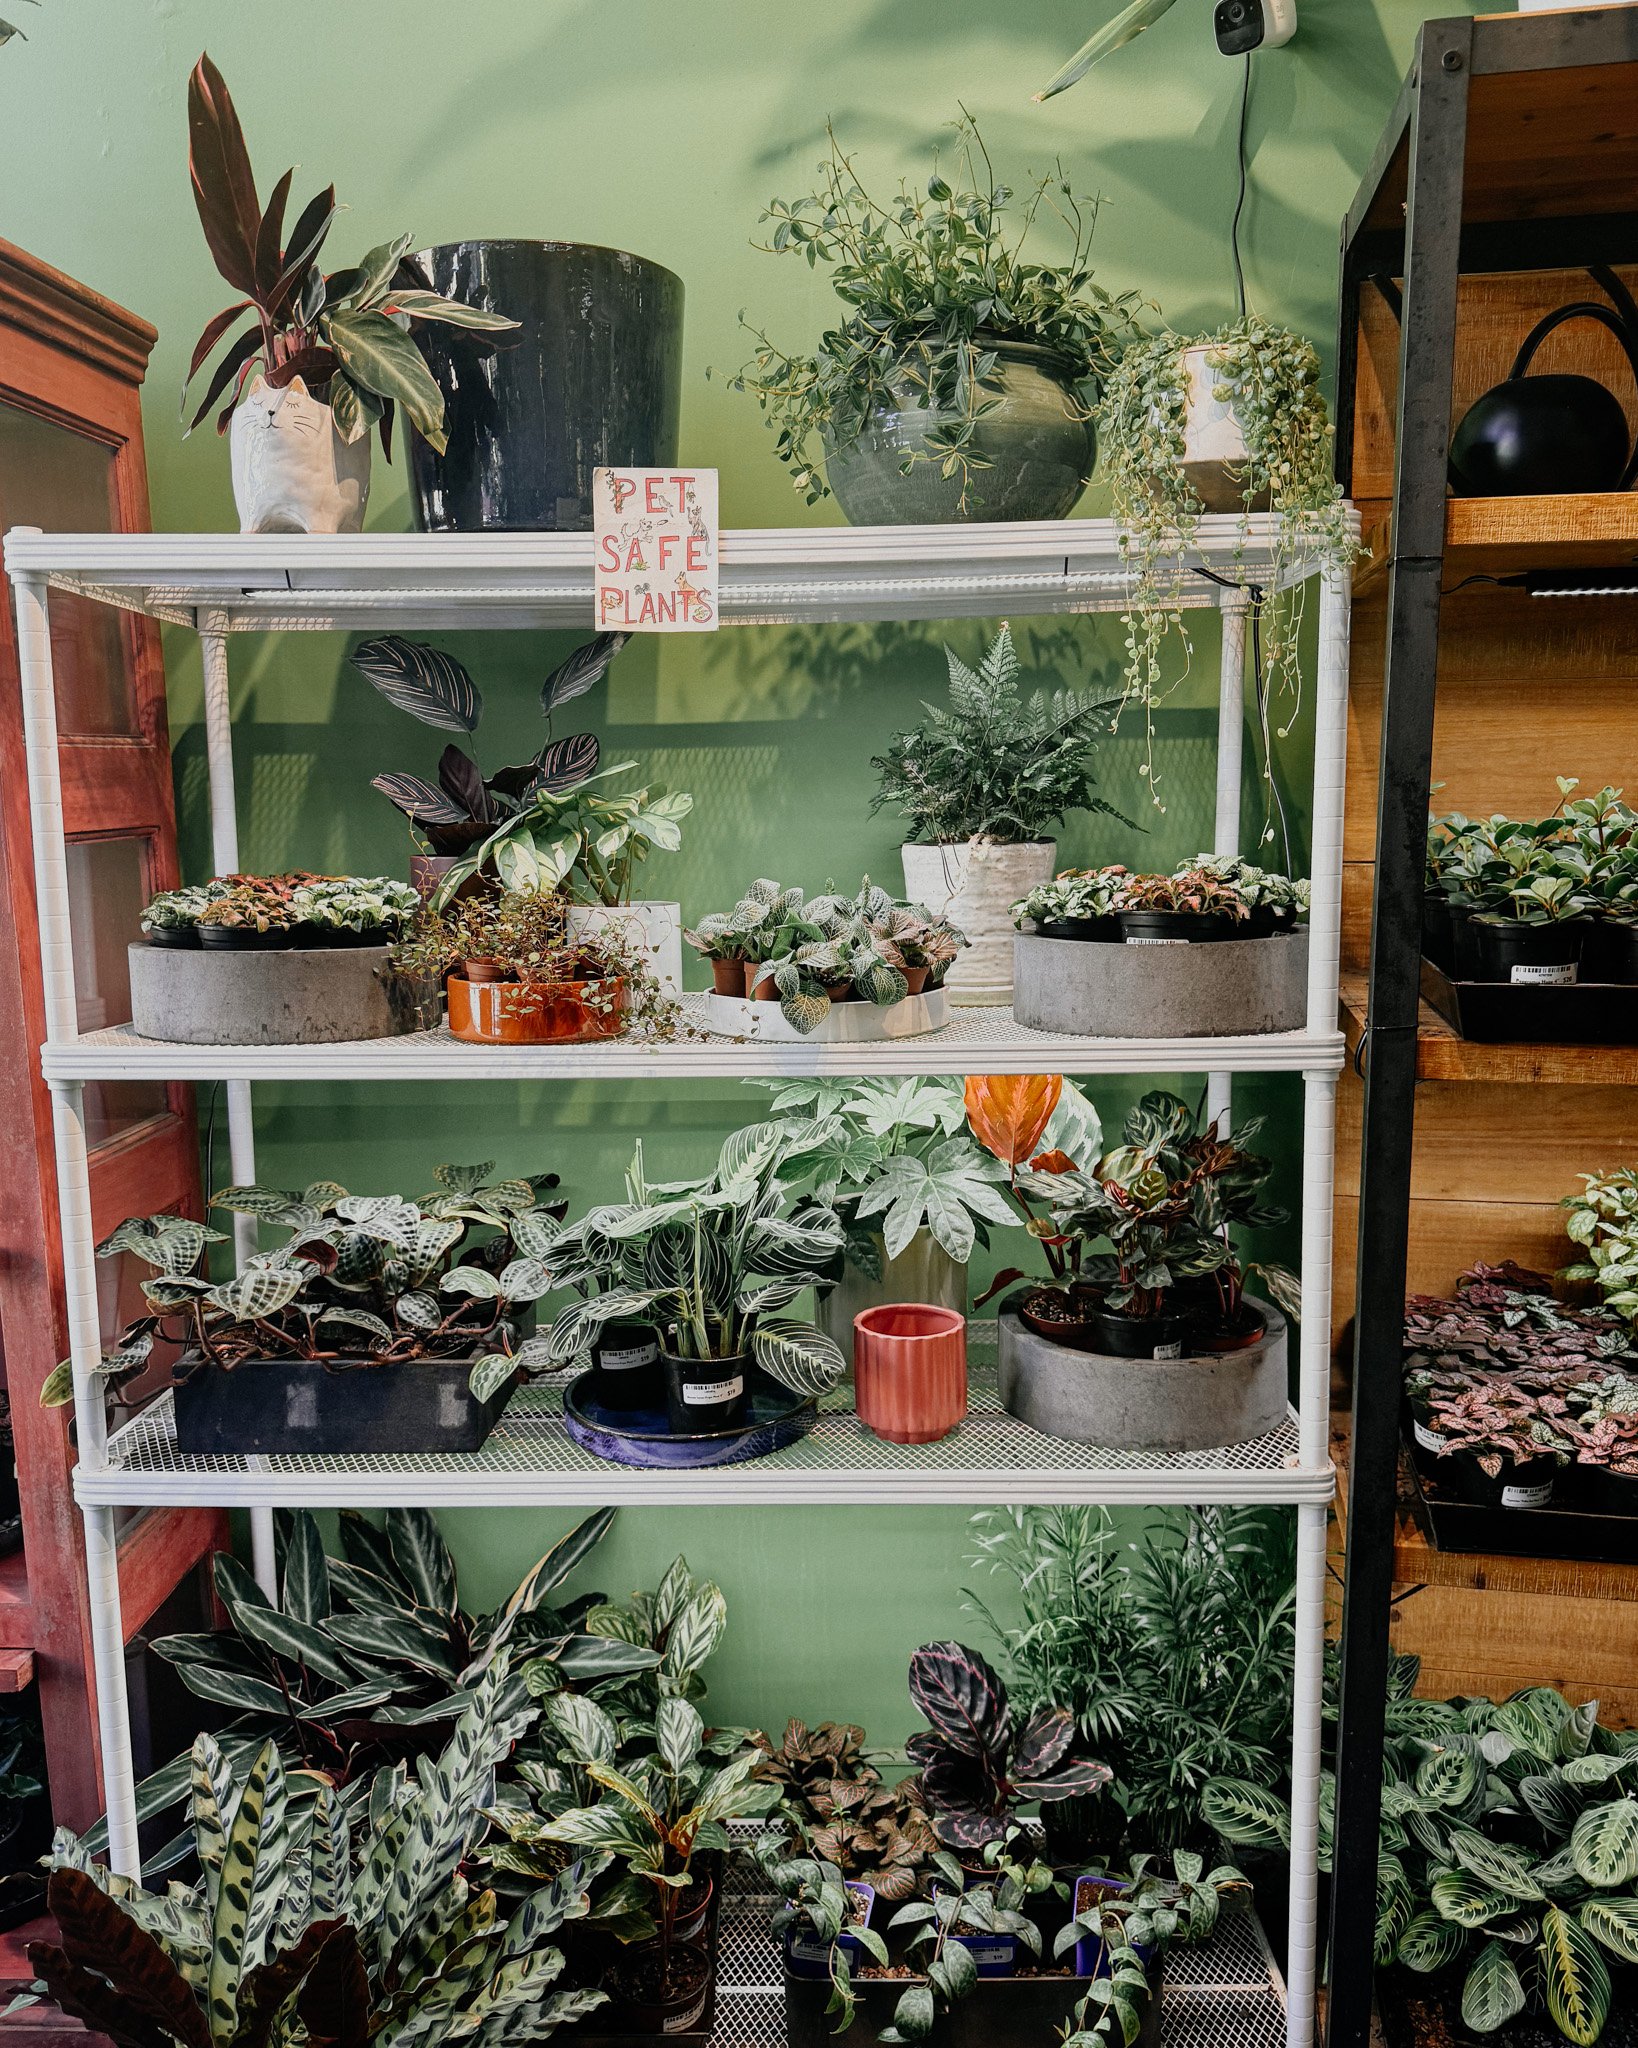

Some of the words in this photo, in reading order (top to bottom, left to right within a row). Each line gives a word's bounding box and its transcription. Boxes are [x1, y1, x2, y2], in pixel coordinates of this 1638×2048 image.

[614, 477, 696, 514] PET
[598, 535, 708, 573] SAFE
[600, 586, 713, 625] PLANTS
